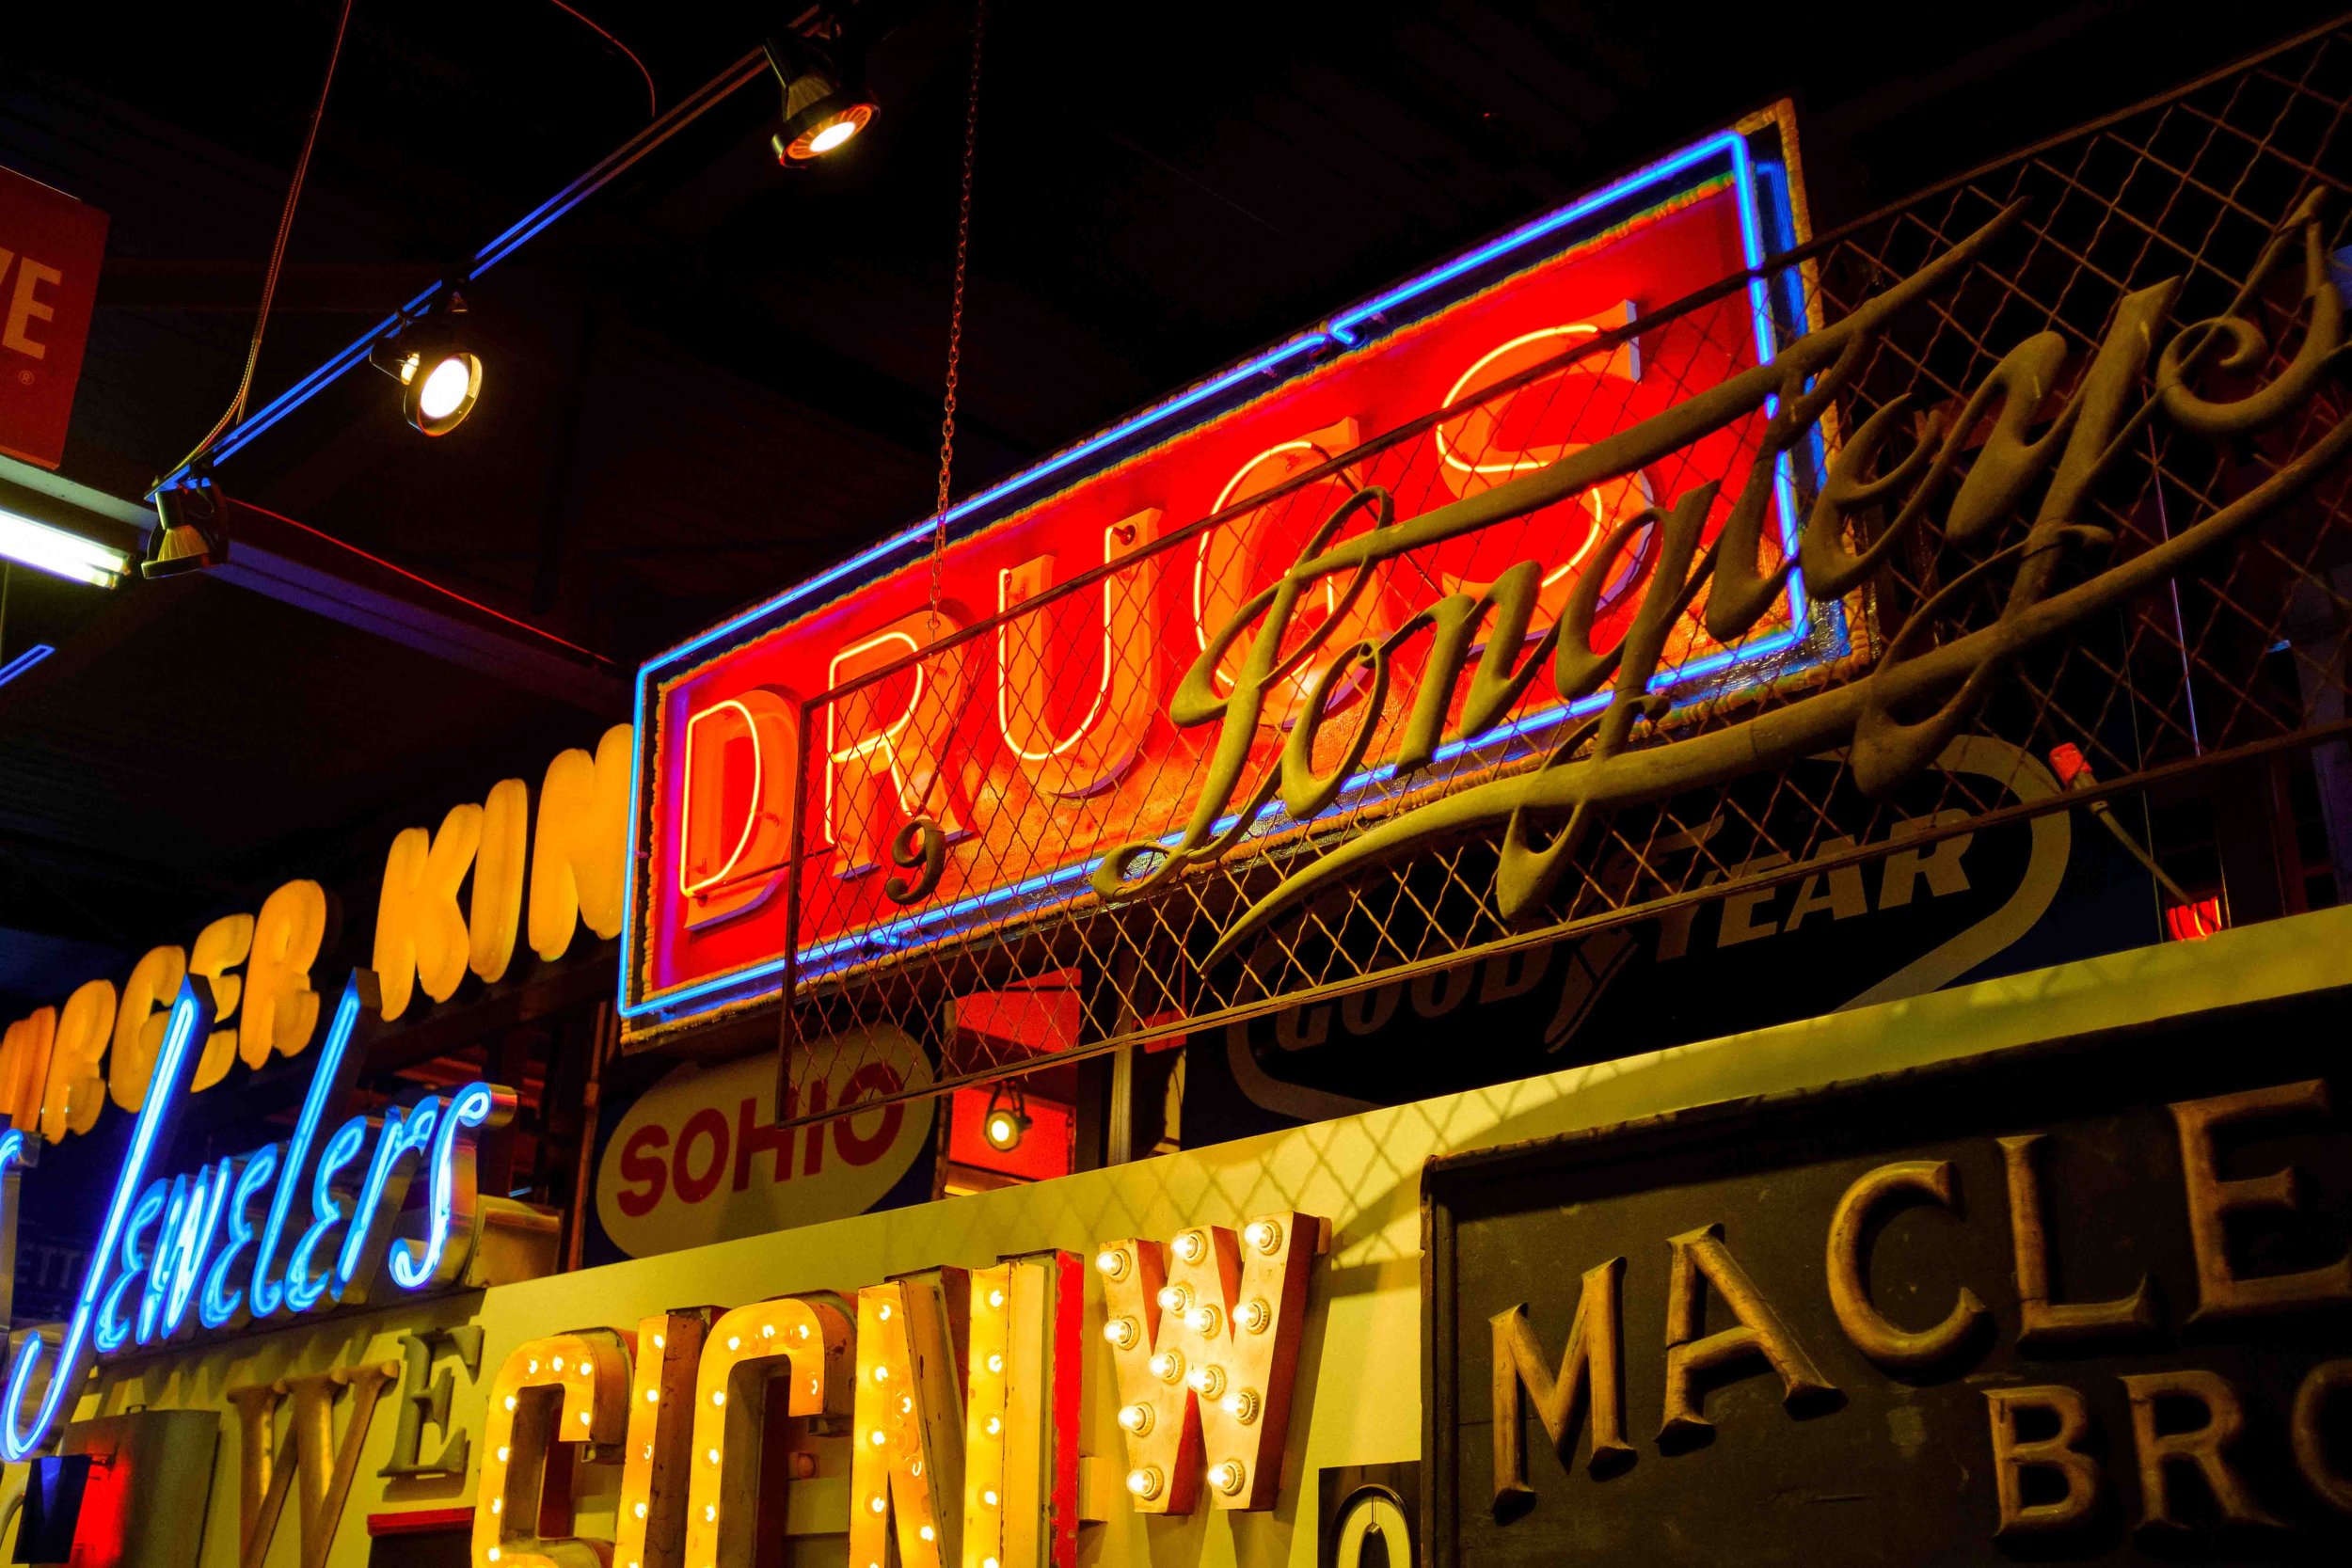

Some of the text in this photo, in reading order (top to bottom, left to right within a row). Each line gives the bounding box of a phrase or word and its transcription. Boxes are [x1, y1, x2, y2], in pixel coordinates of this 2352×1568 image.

[679, 299, 1656, 933] DRUGS
[616, 1062, 905, 1218] SOHIO
[1489, 1078, 2352, 1526] MACLE
